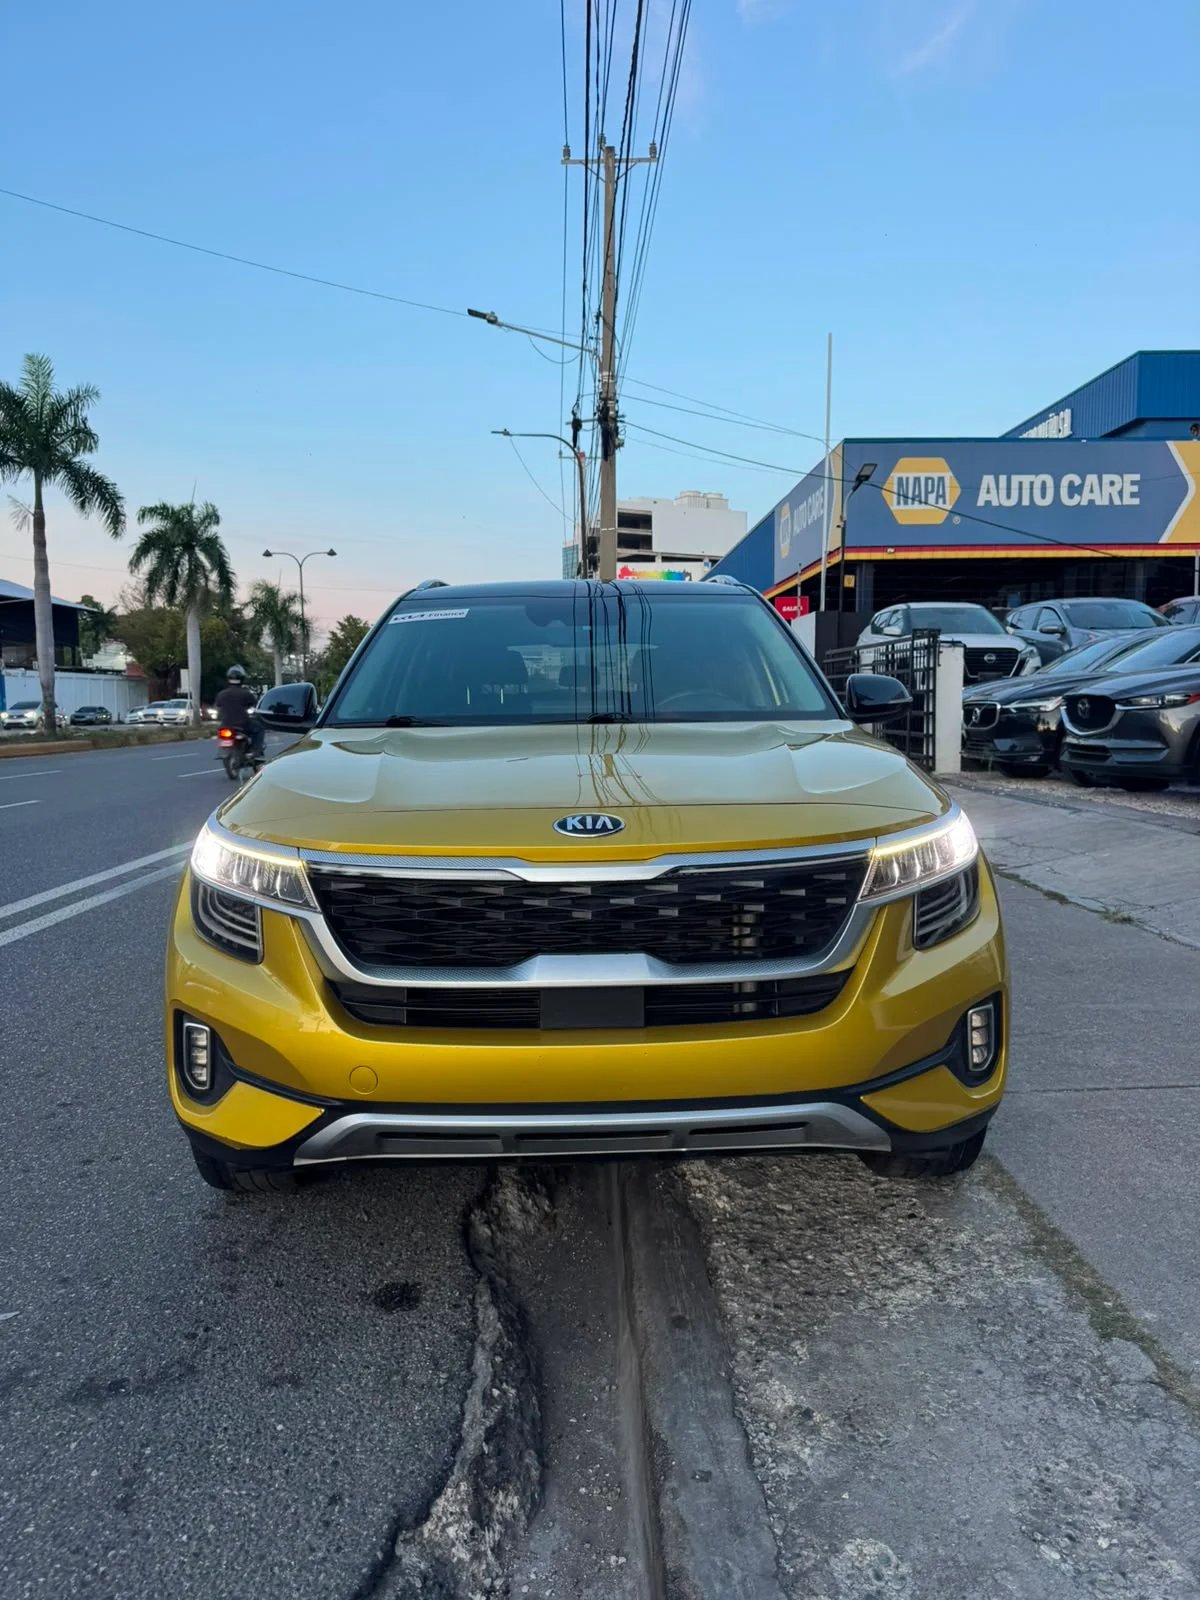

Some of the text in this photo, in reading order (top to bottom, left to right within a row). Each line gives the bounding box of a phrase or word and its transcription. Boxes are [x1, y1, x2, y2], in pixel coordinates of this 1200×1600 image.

[896, 476, 947, 507] NAPA
[976, 473, 1141, 507] AUTO CARE
[566, 815, 614, 830] KIA
